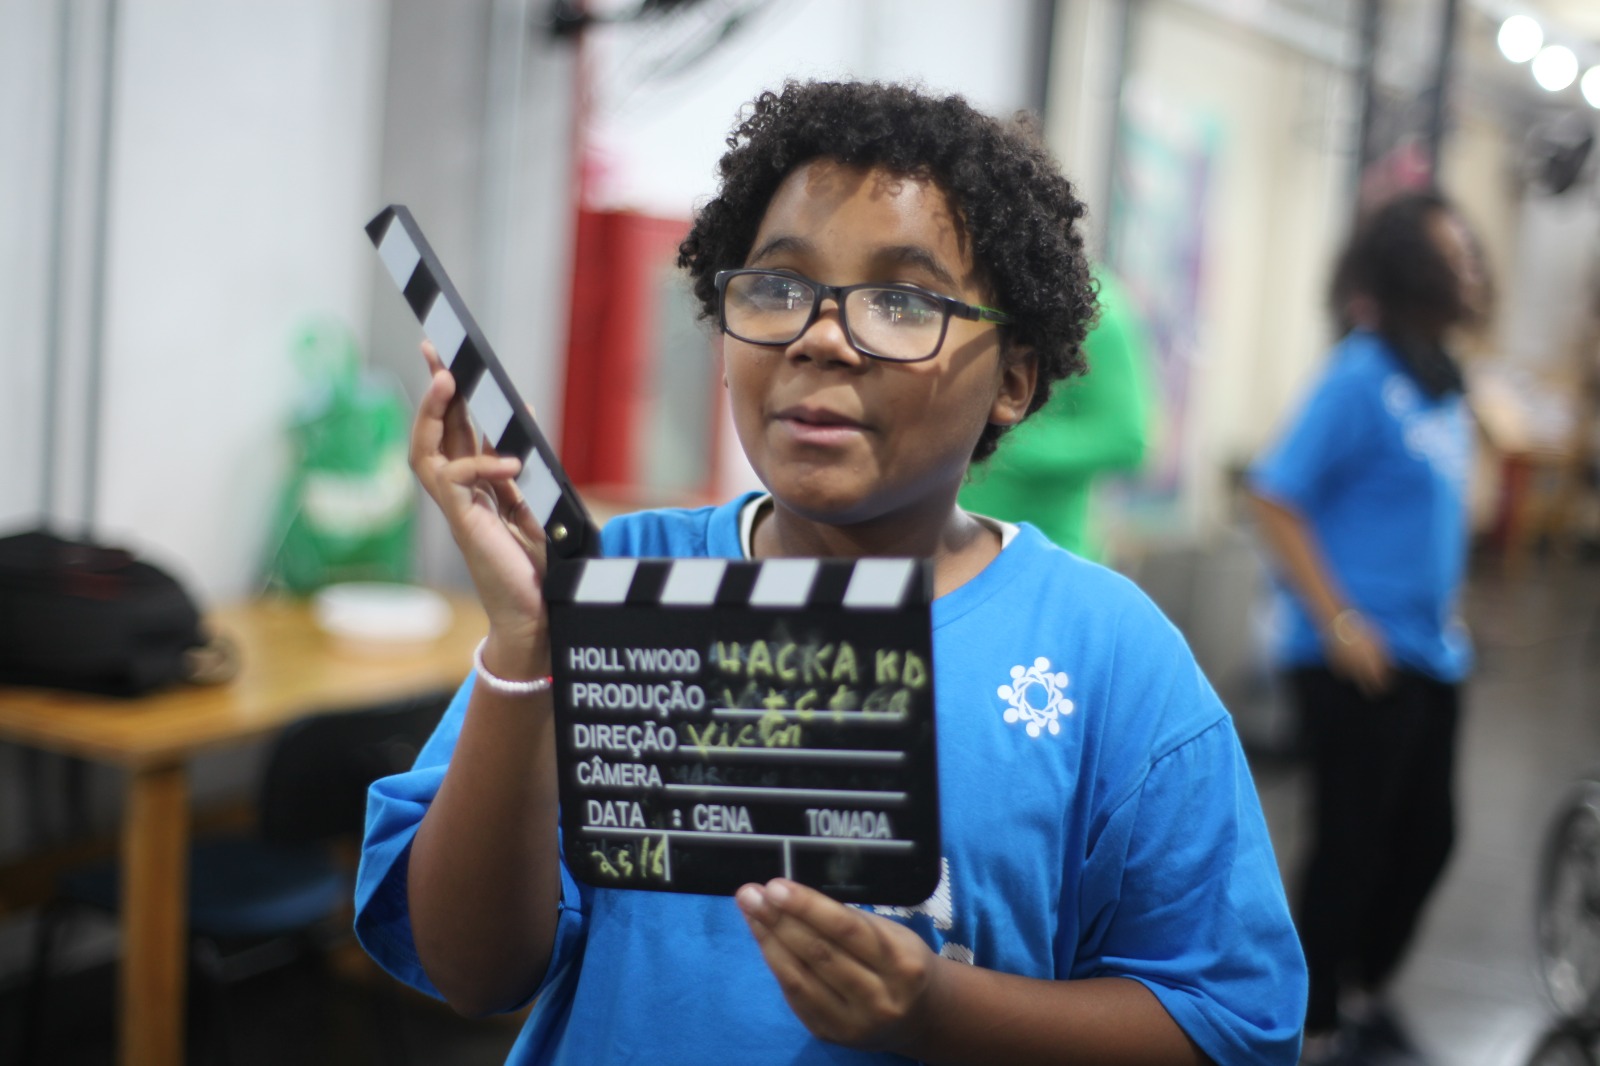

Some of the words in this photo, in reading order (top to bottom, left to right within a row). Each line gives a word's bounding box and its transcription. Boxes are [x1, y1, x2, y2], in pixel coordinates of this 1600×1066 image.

[569, 646, 701, 672] HOLLYWOOD
[572, 680, 706, 717] PRODUÇÃO
[573, 720, 677, 758] DIREÇÃO
[576, 755, 663, 787] CÂMERA
[587, 799, 647, 828] DATA
[692, 803, 753, 832] CENA
[805, 808, 893, 839] TOMADA
